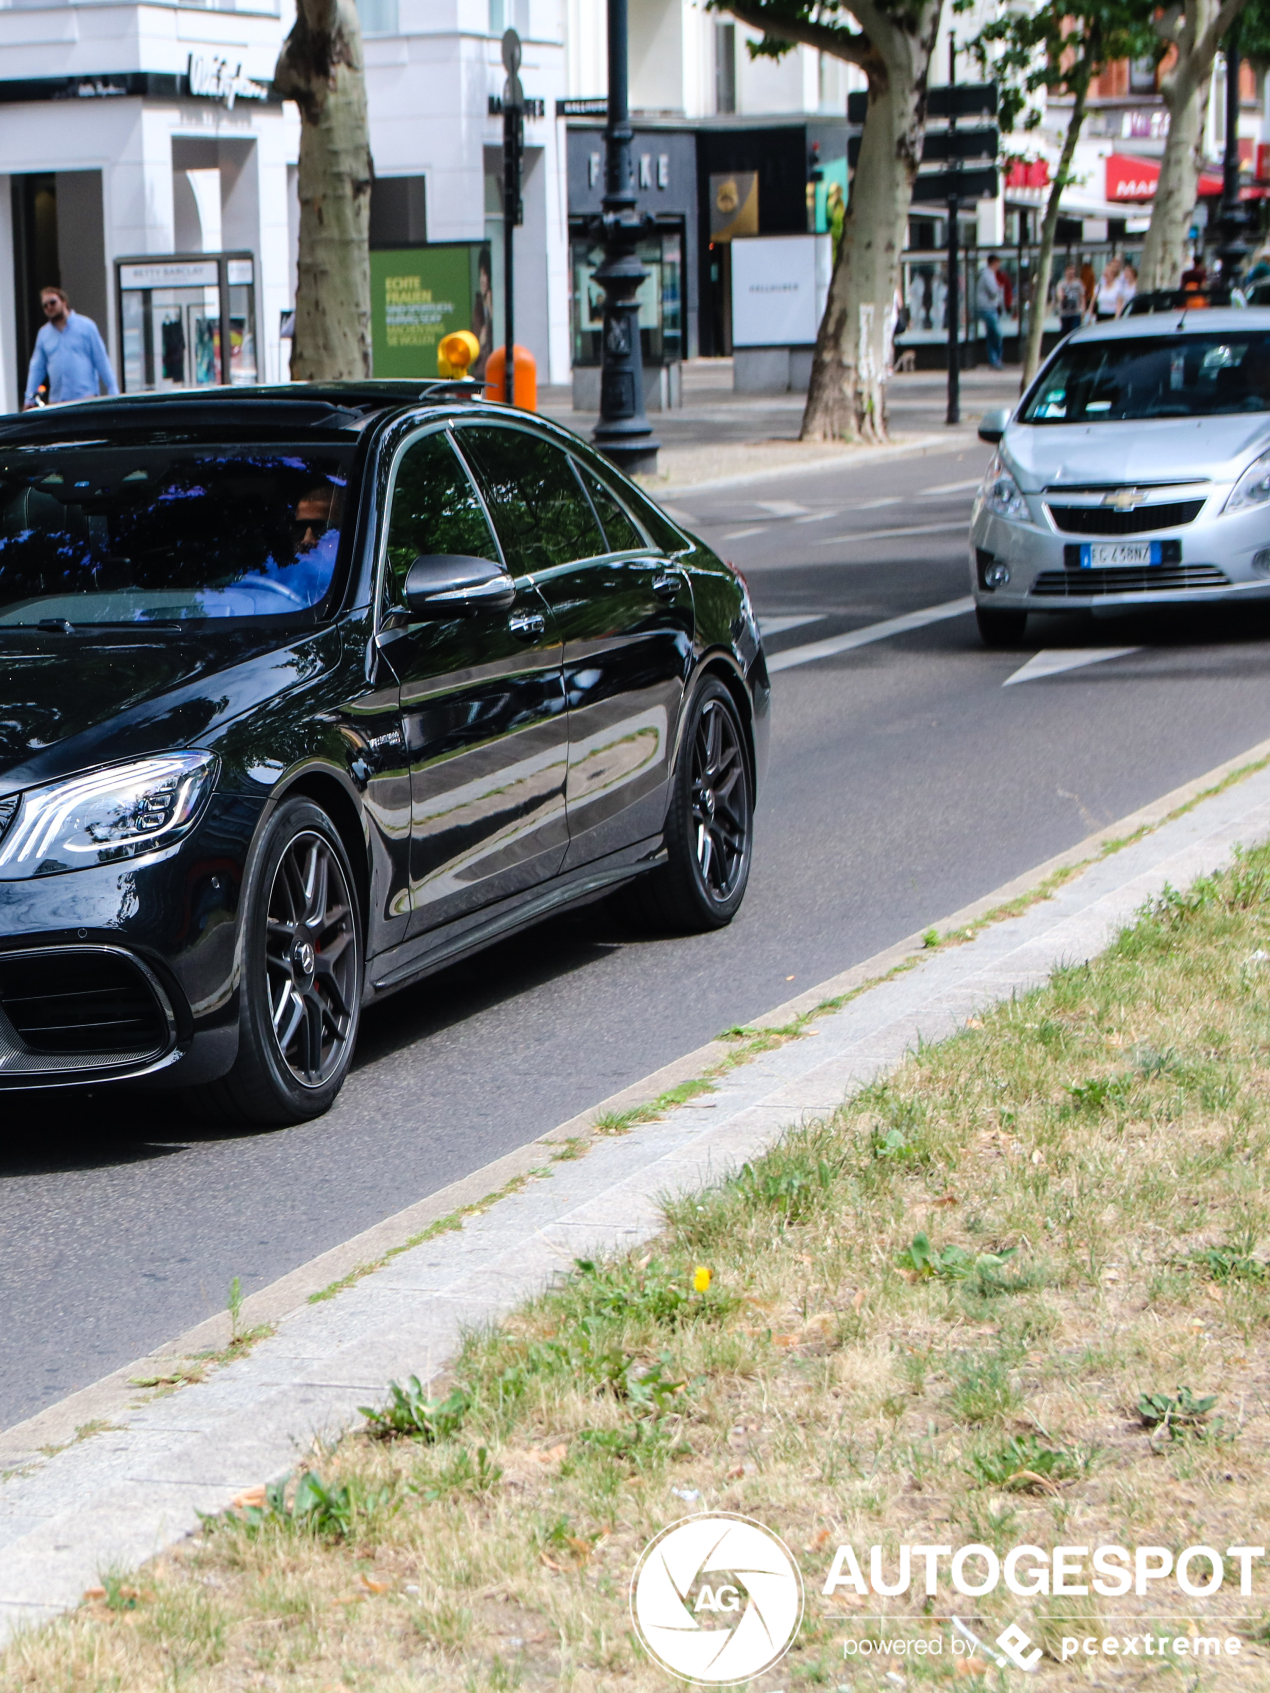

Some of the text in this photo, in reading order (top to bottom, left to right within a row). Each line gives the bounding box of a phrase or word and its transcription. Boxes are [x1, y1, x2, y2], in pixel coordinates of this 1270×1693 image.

[588, 151, 670, 191] FKE
[385, 276, 421, 290] ECHTE
[385, 289, 432, 304] FRAUEN
